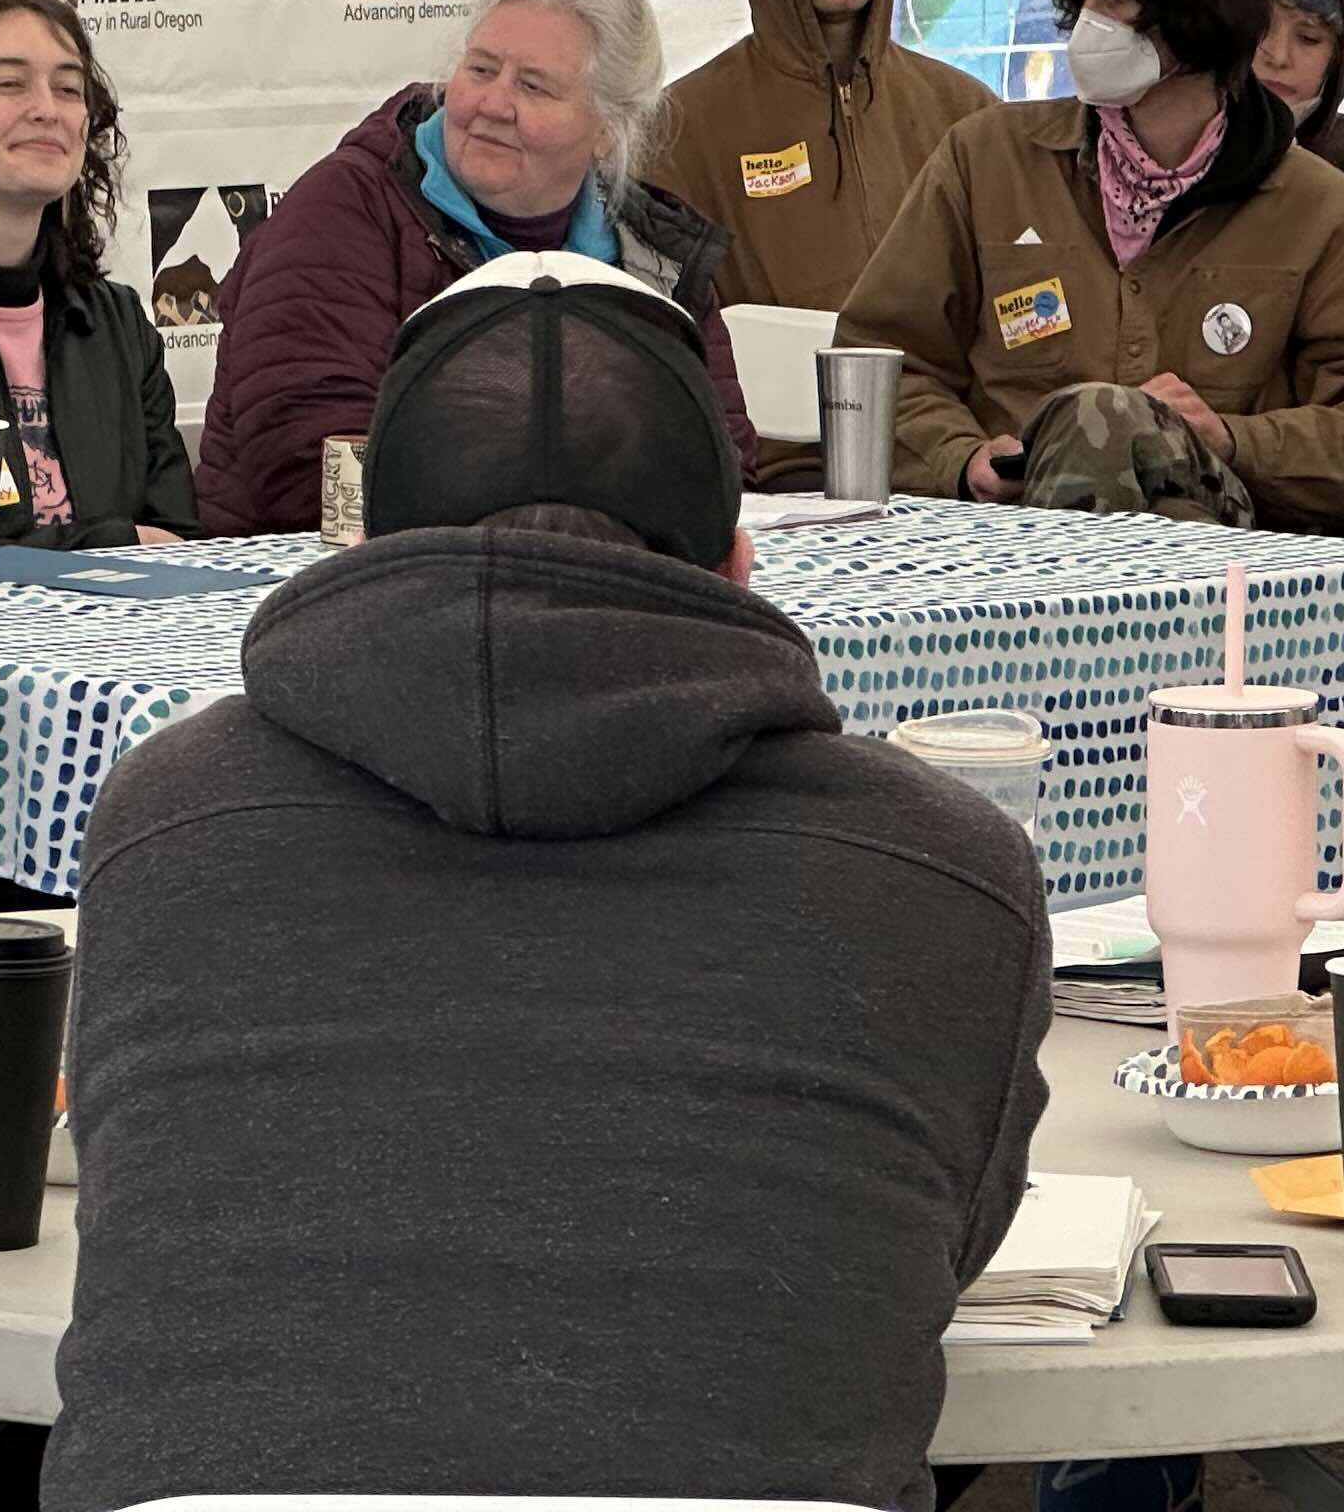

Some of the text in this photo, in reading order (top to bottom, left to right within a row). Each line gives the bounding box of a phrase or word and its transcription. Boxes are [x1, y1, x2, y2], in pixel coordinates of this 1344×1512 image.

[106, 13, 116, 30] in
[120, 12, 151, 29] Rural
[156, 10, 202, 31] Oregon
[344, 3, 415, 23] Advancing
[746, 159, 783, 170] hello
[999, 295, 1033, 315] hello
[321, 441, 342, 537] LUCKY
